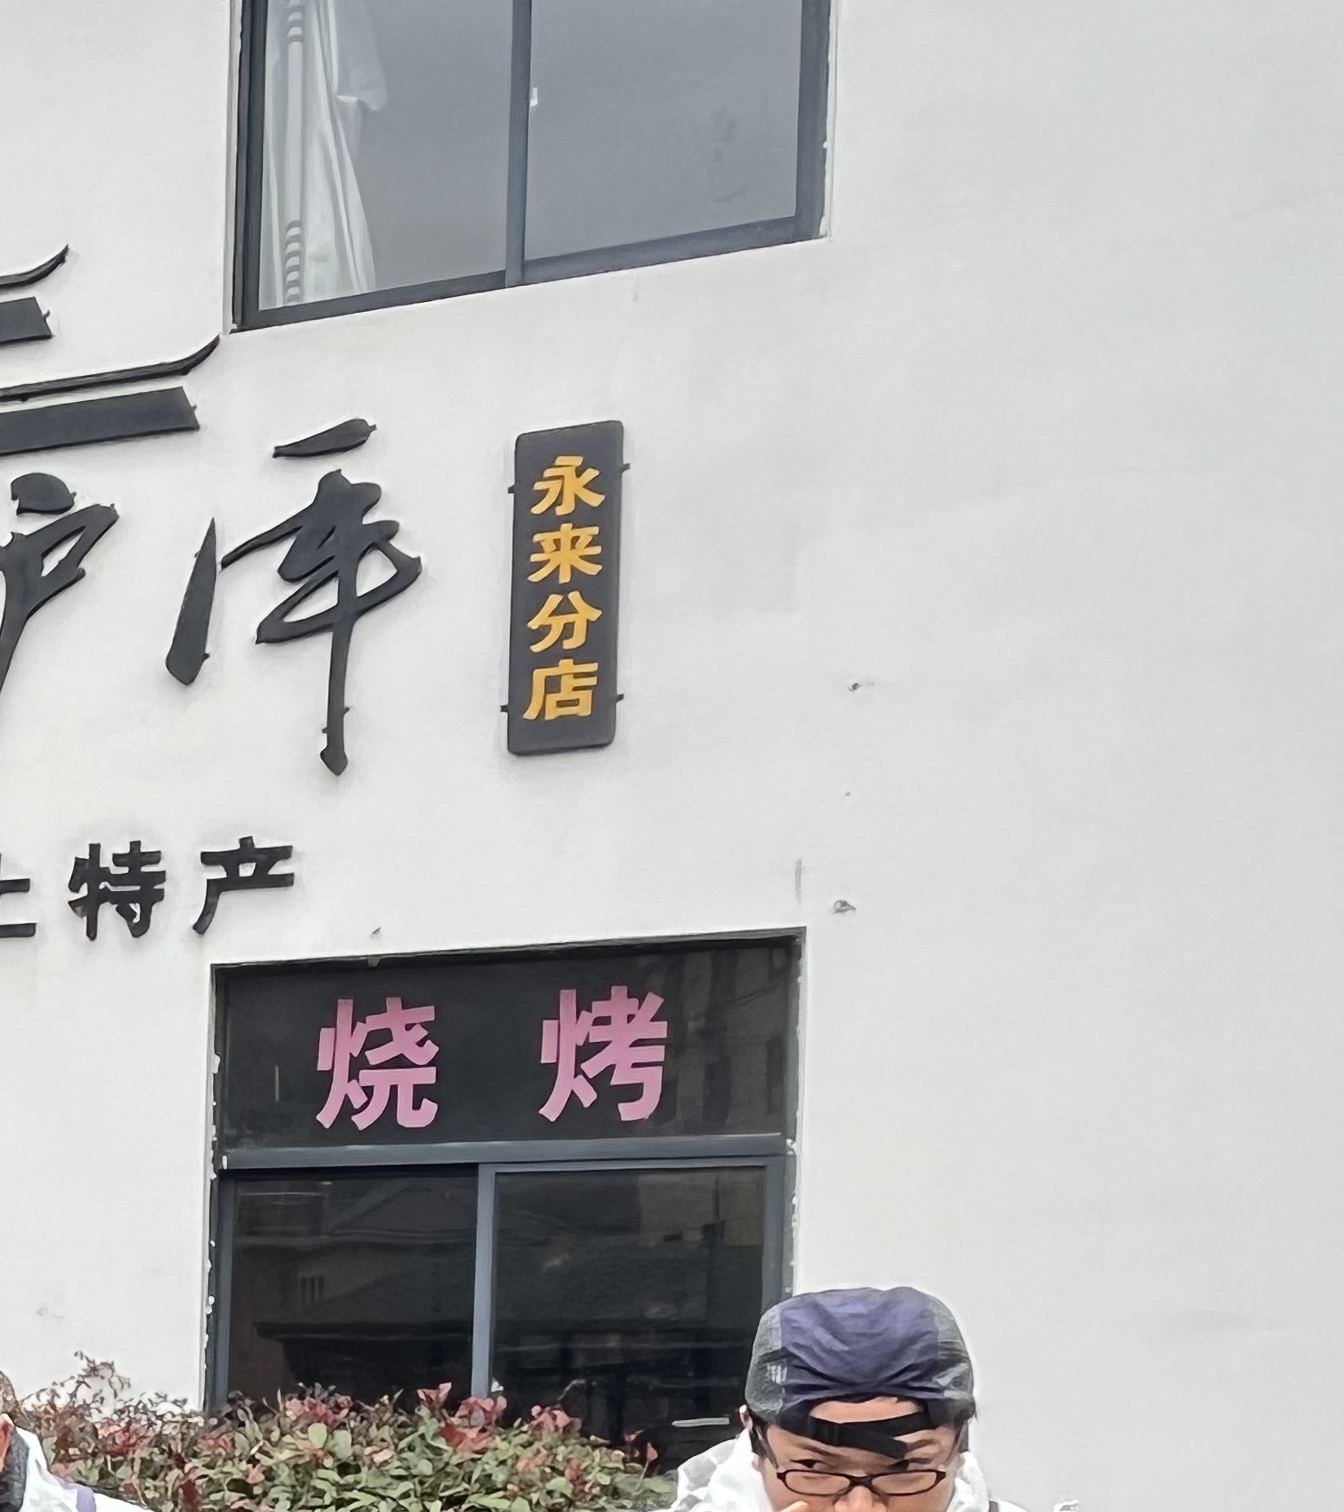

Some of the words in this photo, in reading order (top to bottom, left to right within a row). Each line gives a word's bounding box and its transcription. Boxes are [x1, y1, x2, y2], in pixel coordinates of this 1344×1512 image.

[521, 455, 606, 721] 永来分店
[316, 985, 669, 1131] 烧烤
